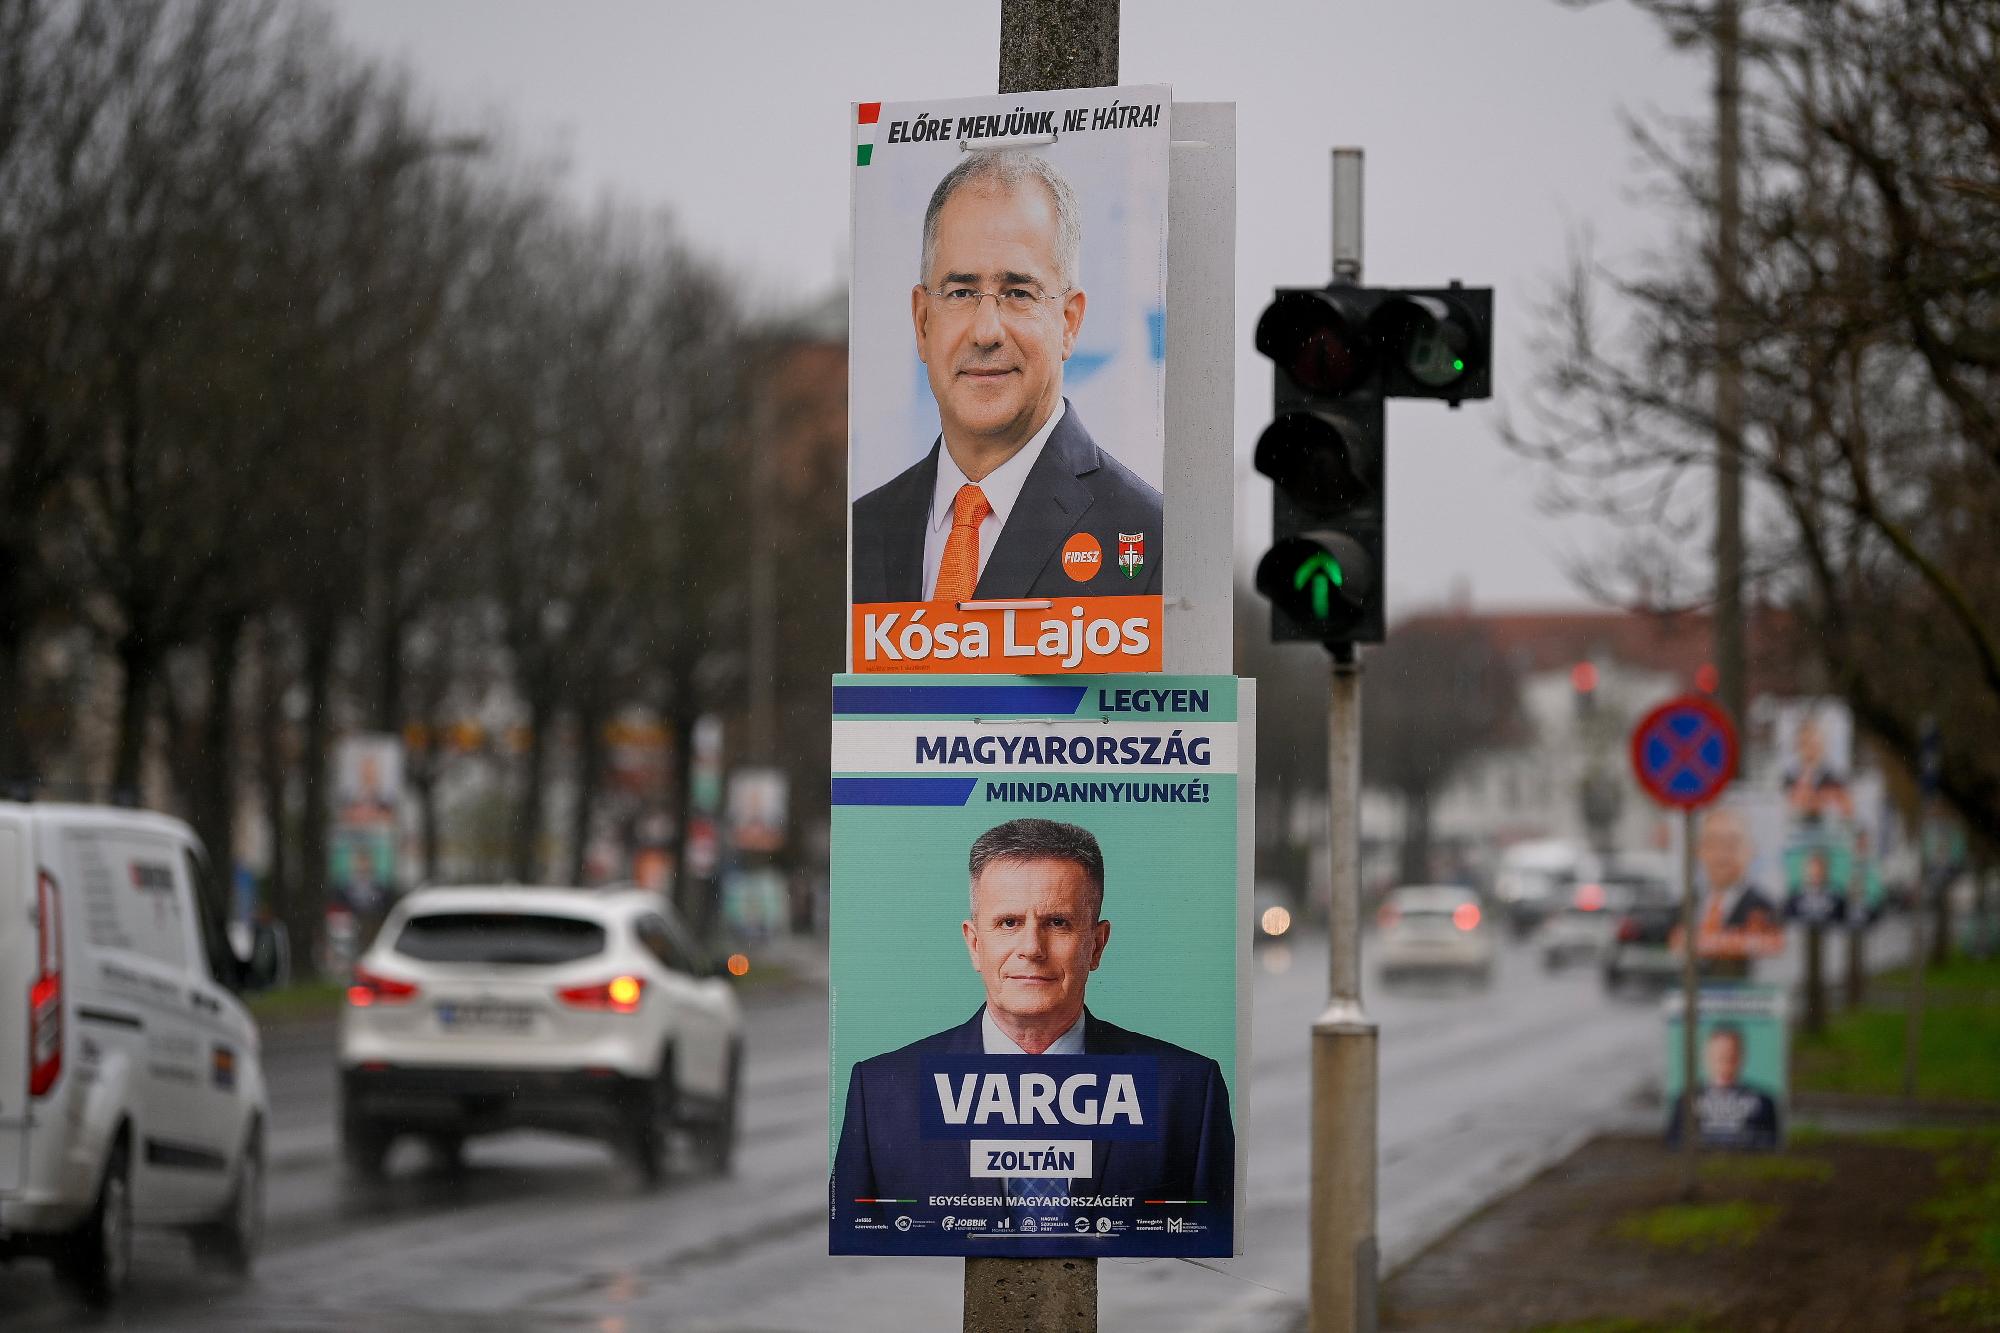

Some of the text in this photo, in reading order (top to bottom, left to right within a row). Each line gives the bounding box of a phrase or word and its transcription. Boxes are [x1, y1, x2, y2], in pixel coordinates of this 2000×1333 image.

[888, 100, 1161, 144] ELŐRE MENJÜNK, NE HÁTRA!
[1064, 550, 1100, 564] FIDESZ
[864, 605, 1151, 669] Kósa Lajos
[1098, 689, 1209, 713] LEGYEN
[915, 729, 1211, 766] MAGYARORSZÁG
[986, 778, 1210, 803] MINDANNYIUNKÉ!
[934, 1073, 1144, 1125] VARGA
[987, 1146, 1075, 1171] ZOLTÁN
[929, 1194, 1135, 1208] EGYSÉGBEN MAGYARORSZÁGÉRT
[954, 1219, 988, 1227] JOBBIK
